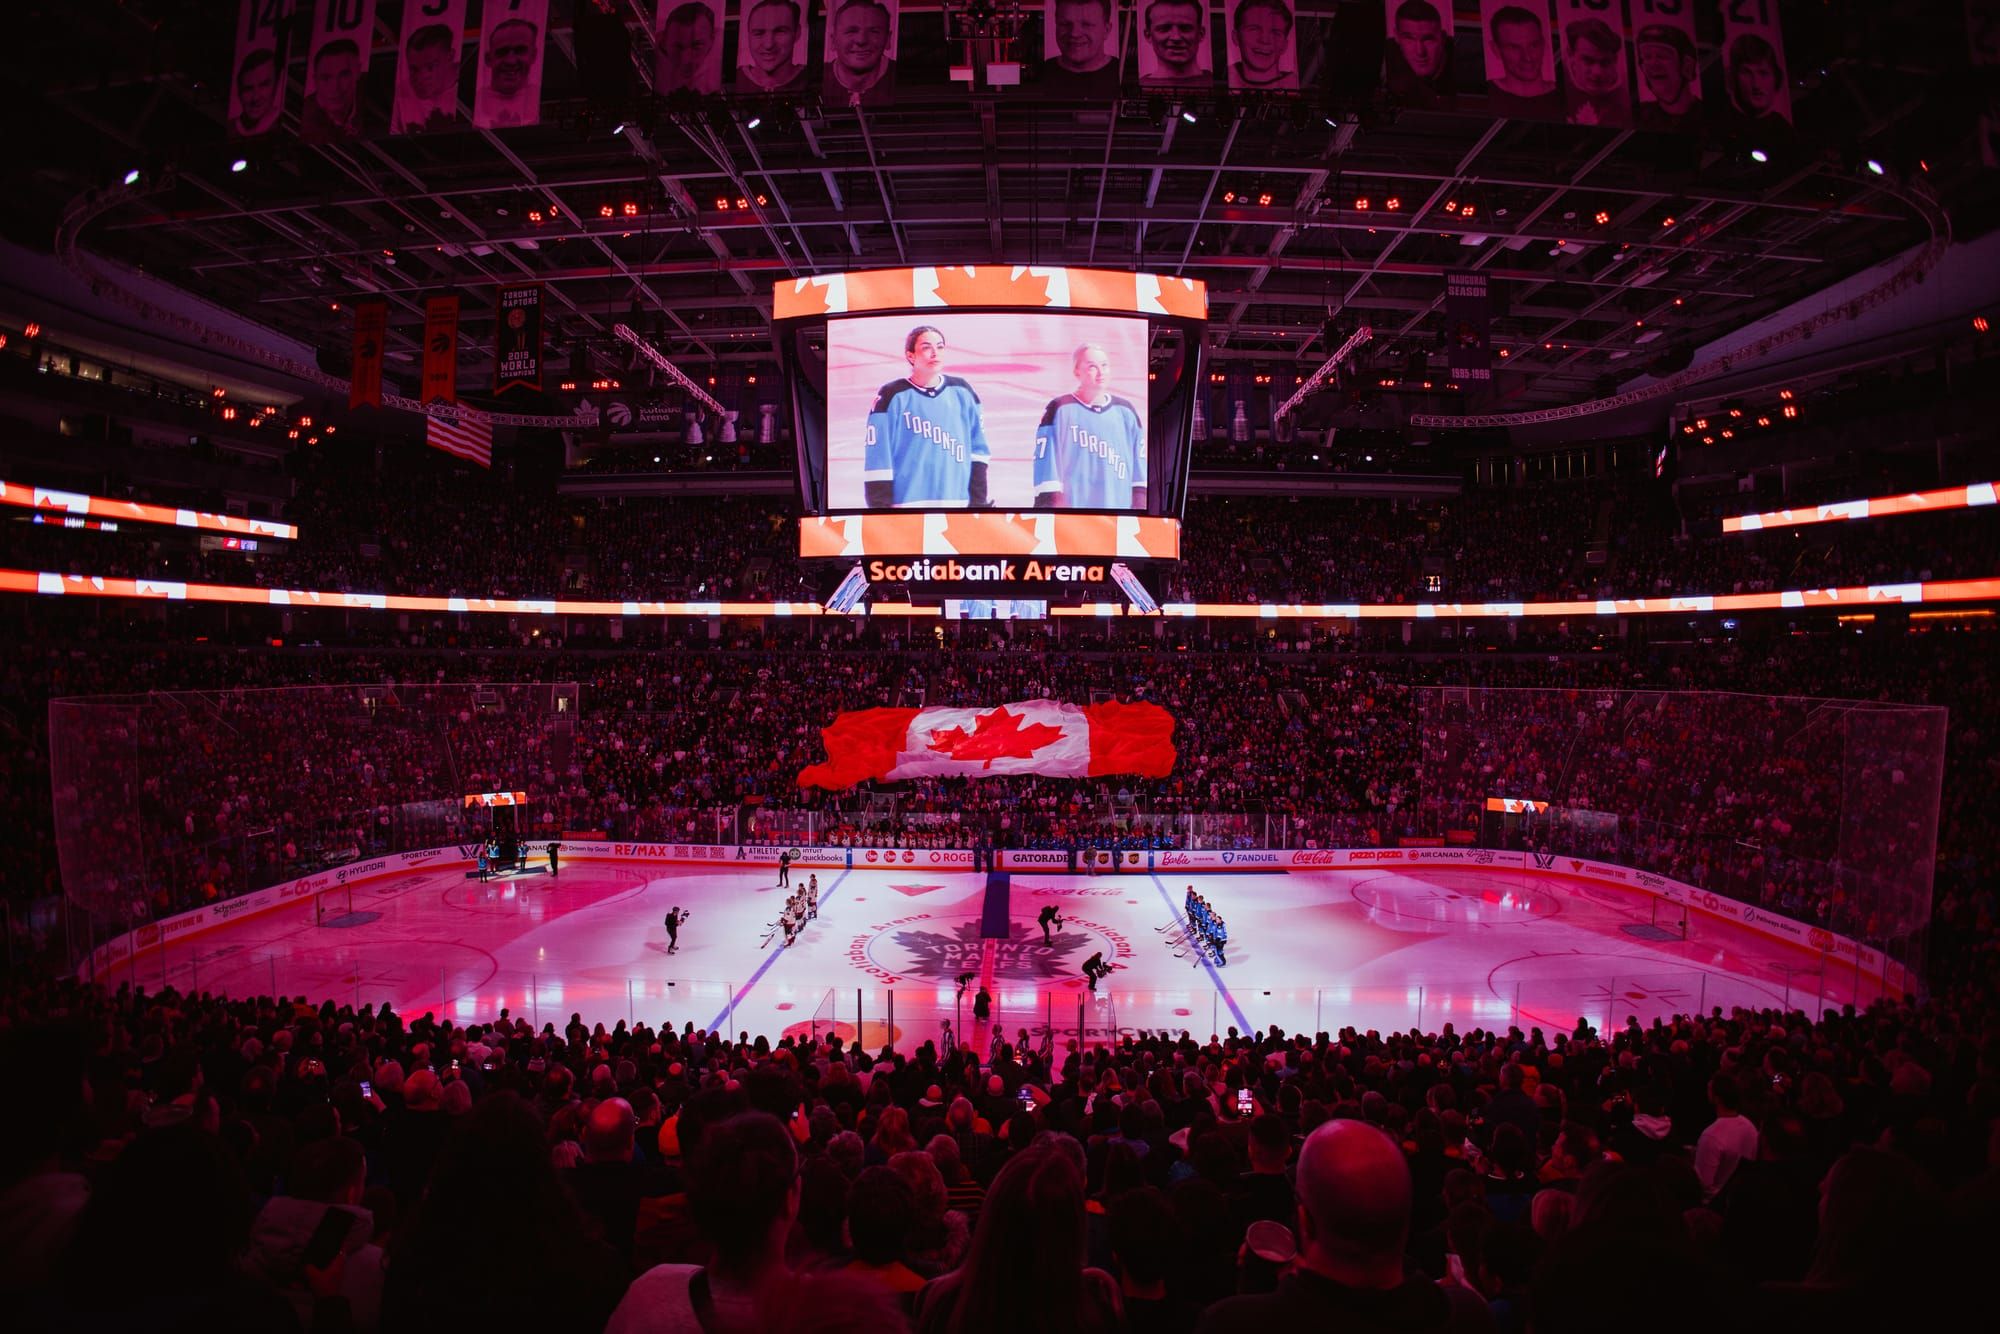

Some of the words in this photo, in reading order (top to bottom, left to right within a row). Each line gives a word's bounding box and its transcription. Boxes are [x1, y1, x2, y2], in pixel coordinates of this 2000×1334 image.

[1447, 274, 1487, 286] INAUGURAL
[503, 289, 538, 299] TORONTO
[1447, 286, 1487, 297] SEASON
[502, 297, 538, 308] RAPTORS
[500, 359, 536, 371] WORLD
[903, 411, 964, 463] TORONTO
[1070, 425, 1126, 479] TORONTO
[870, 559, 1015, 582] Scotiabank
[1024, 560, 1104, 582] Arena
[614, 844, 666, 857] RE/MAX
[749, 847, 779, 856] ATHLETIC
[1349, 851, 1375, 861] pizza
[1377, 850, 1403, 861] pizza
[1436, 851, 1464, 859] CANADA
[802, 854, 843, 862] quickbooks
[1161, 852, 1190, 865] Barbie
[1236, 854, 1279, 862] FANDUEL
[349, 861, 386, 876] HYUNDAI
[1635, 871, 1665, 886] Schneider
[213, 898, 250, 917] Schneider
[870, 913, 931, 931] Arena
[1064, 916, 1137, 959] Scotiabank
